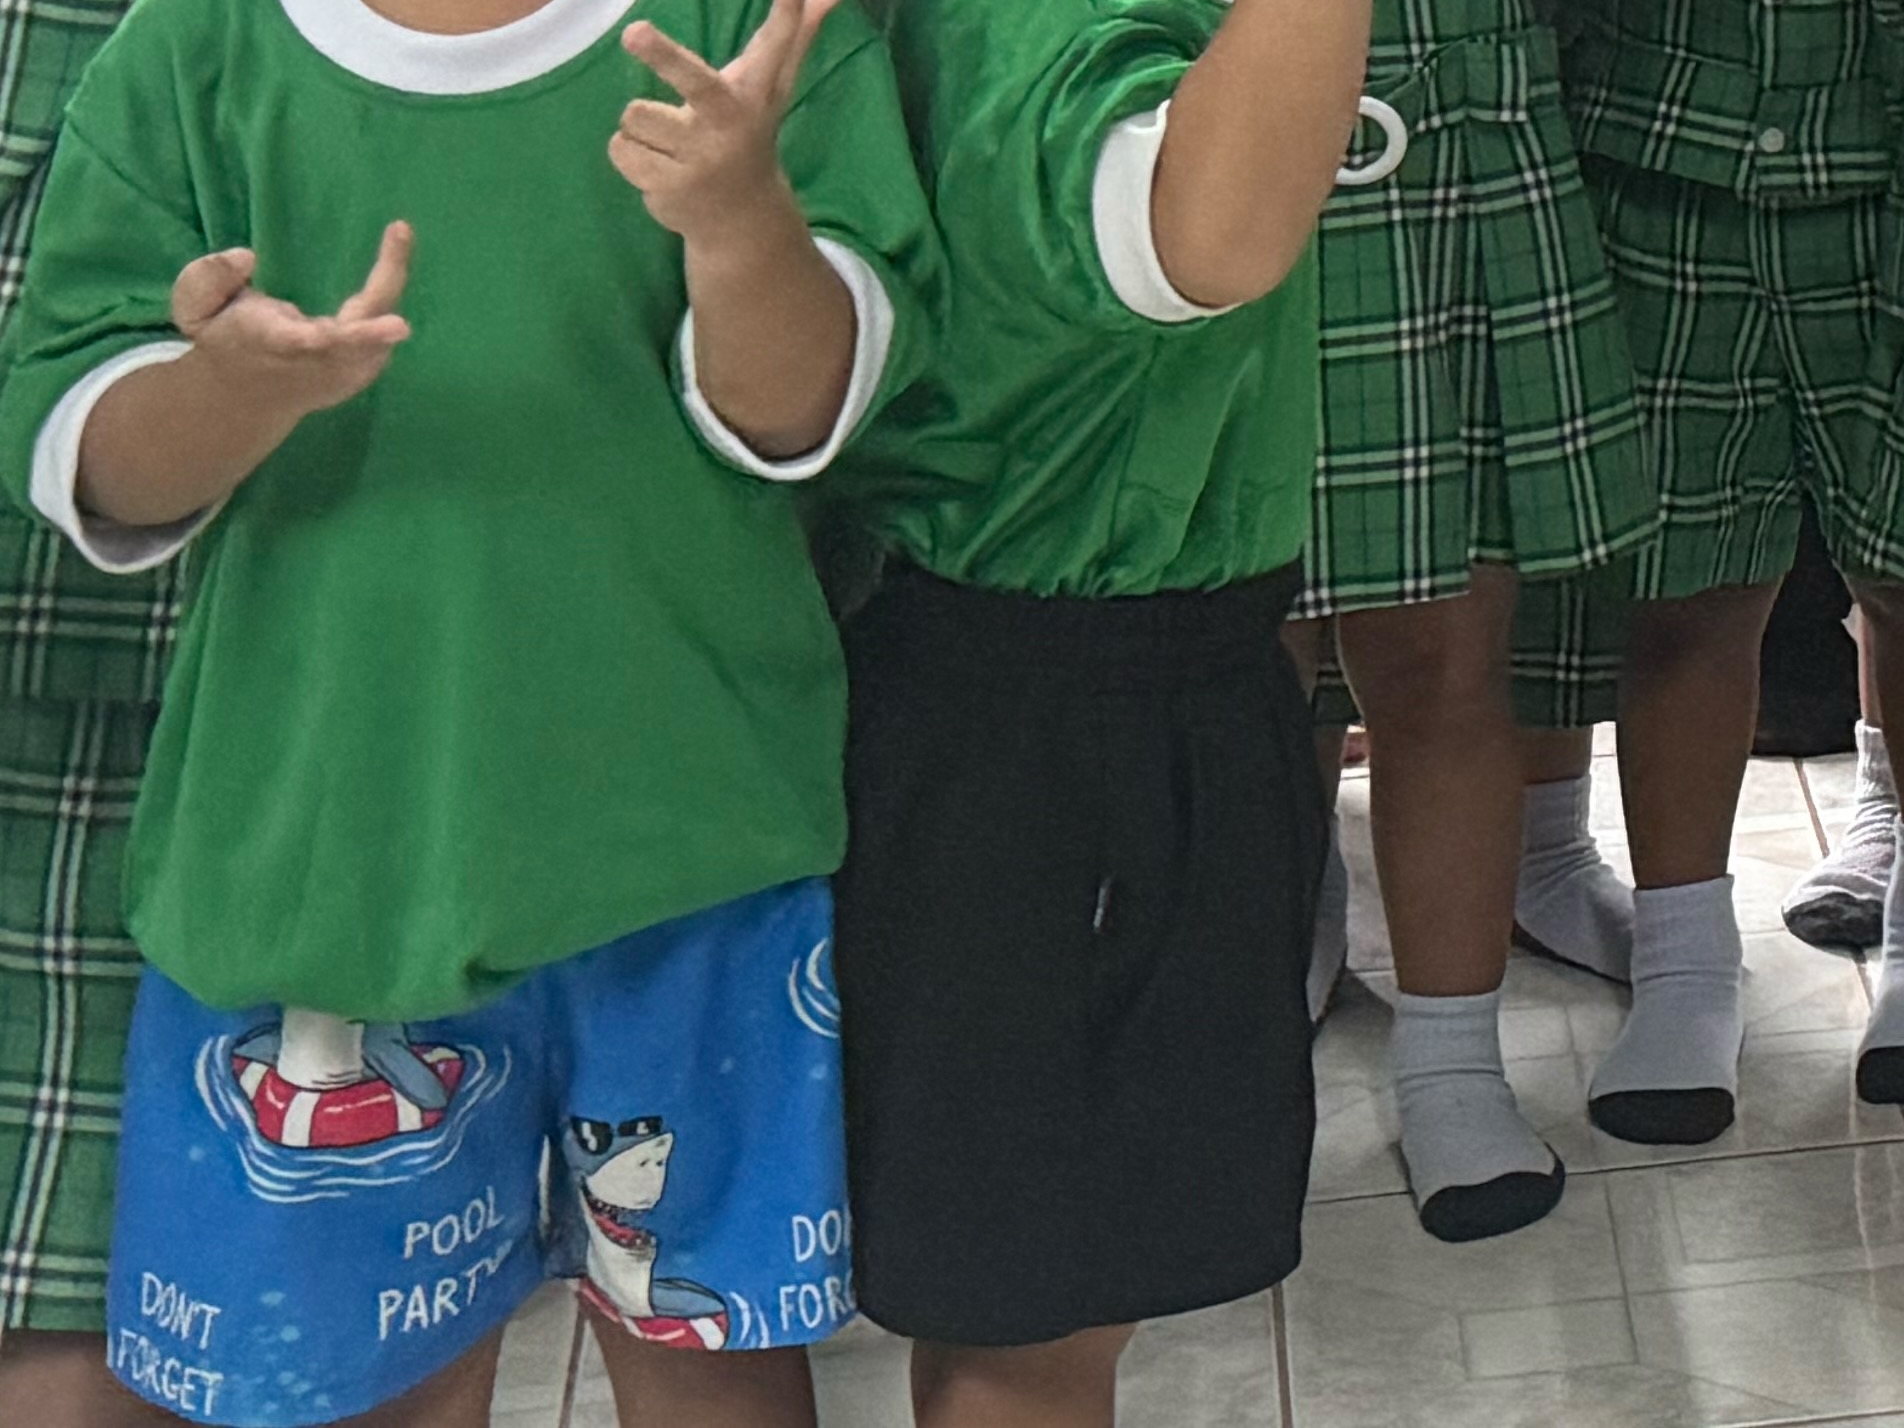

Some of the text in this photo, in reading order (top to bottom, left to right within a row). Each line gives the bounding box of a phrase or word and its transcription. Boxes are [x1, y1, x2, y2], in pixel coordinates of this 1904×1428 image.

[404, 1185, 507, 1260] POOL
[792, 1209, 853, 1262] DO
[141, 1270, 222, 1352] DON'T
[118, 1327, 224, 1417] FORGET
